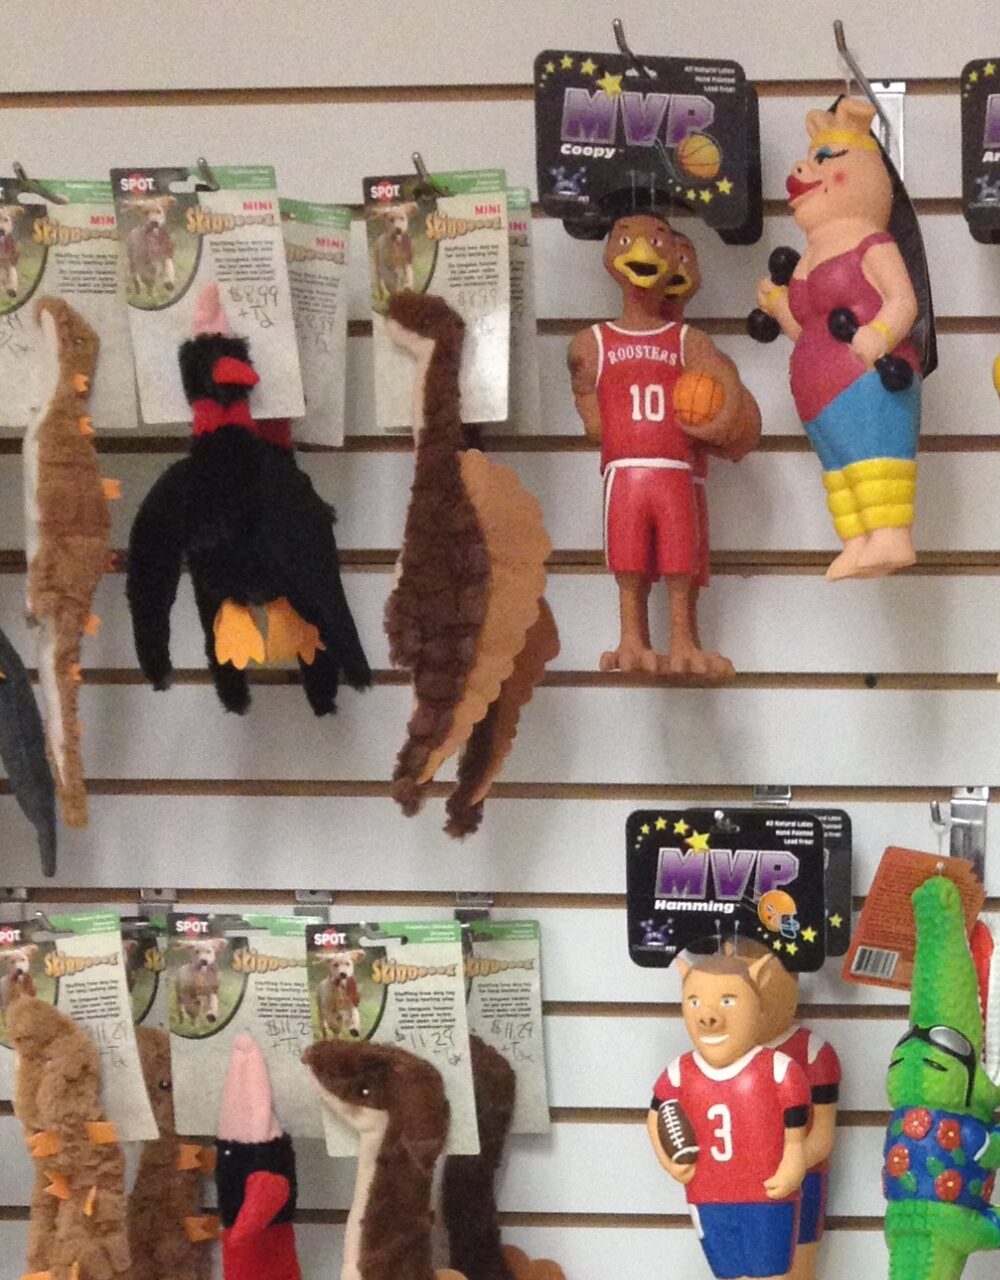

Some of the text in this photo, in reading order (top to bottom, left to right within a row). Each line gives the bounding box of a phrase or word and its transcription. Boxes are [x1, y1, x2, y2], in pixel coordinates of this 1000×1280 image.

[561, 87, 715, 148] MVP
[560, 143, 617, 159] Coopy
[120, 178, 155, 191] SPOT
[371, 185, 400, 198] SPOT
[242, 201, 272, 212] MINI
[474, 205, 501, 215] MINI
[90, 215, 115, 225] MIN
[508, 221, 527, 231] INI
[608, 345, 677, 366] ROOSTERS
[630, 384, 665, 422] 10
[655, 847, 799, 901] MVP
[654, 900, 734, 913] Hamming
[176, 921, 209, 933] SPOT
[0, 929, 21, 942] POT
[314, 933, 346, 945] SPOT
[707, 1103, 733, 1162] 3
